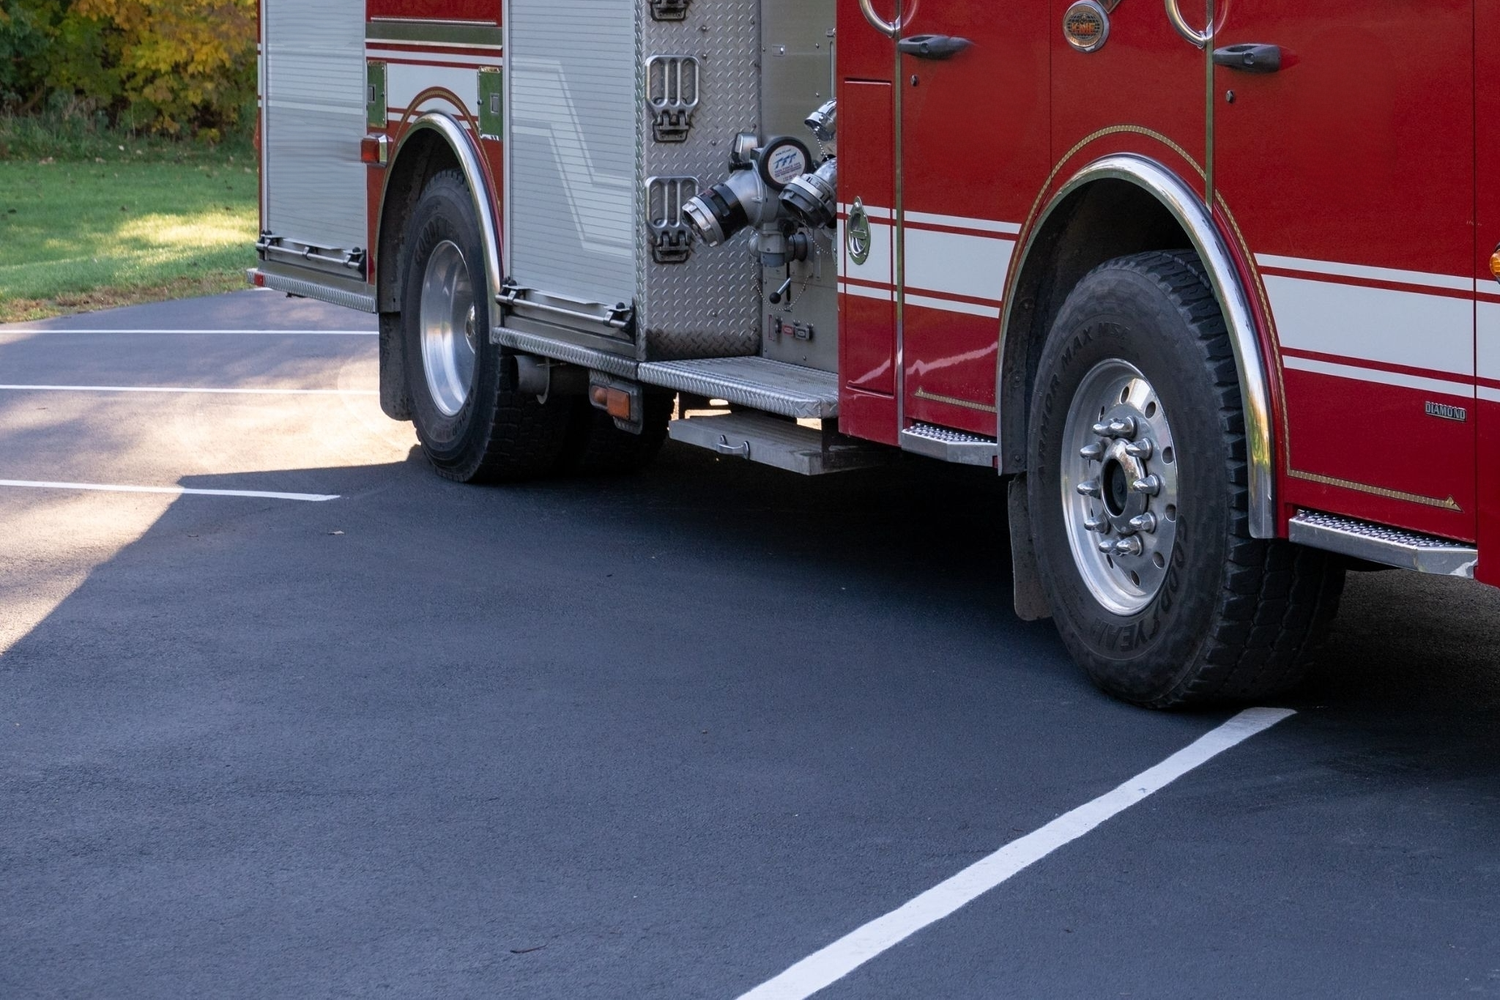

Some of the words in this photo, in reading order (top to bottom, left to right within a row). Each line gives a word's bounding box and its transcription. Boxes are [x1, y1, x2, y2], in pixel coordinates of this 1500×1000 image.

[1071, 22, 1096, 34] KME
[1061, 325, 1094, 369] MAX
[1425, 402, 1466, 420] DIAMOND
[1091, 514, 1188, 652] GOODYEAR
